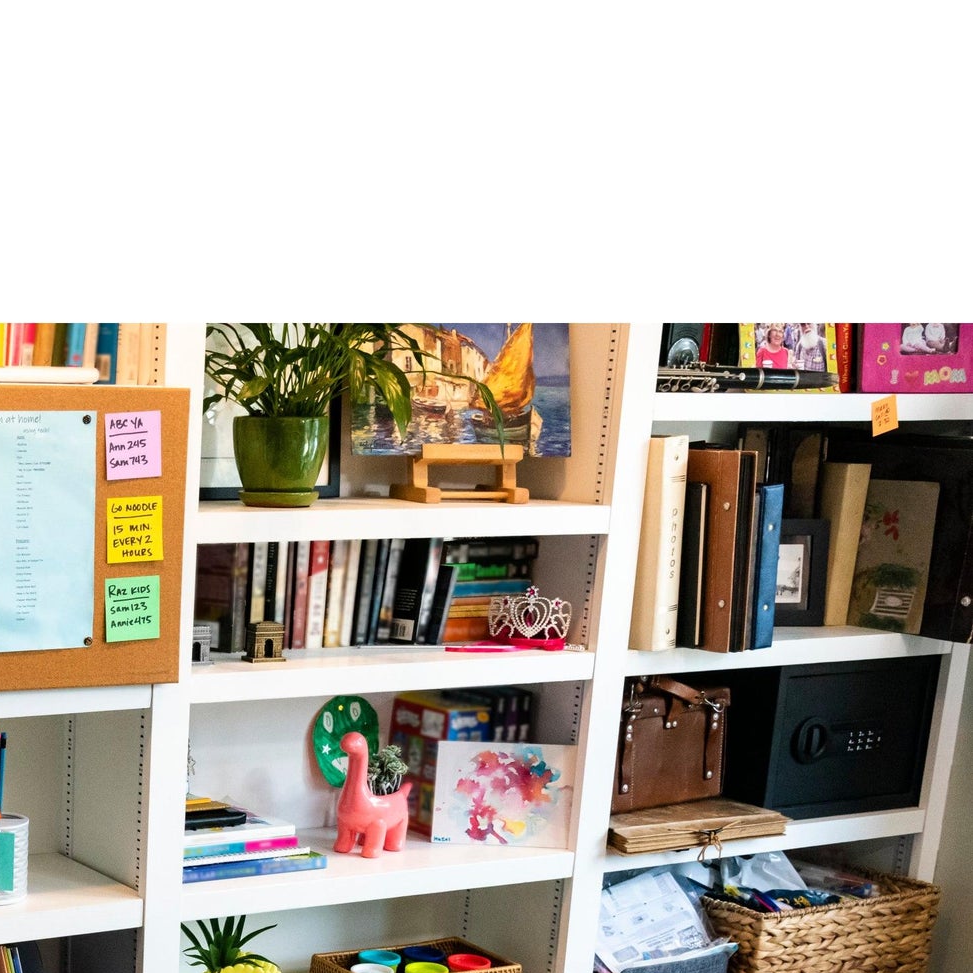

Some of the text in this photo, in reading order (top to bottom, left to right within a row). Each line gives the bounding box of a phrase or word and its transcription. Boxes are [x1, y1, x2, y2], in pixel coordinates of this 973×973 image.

[923, 366, 967, 386] MOM
[5, 415, 16, 424] at
[18, 414, 42, 424] home!
[109, 416, 143, 430] ABC YA
[125, 502, 158, 512] NOODLE
[113, 525, 124, 535] 15
[113, 535, 153, 548] EVERY 2
[122, 548, 153, 558] HOURS
[130, 584, 151, 595] KIDS
